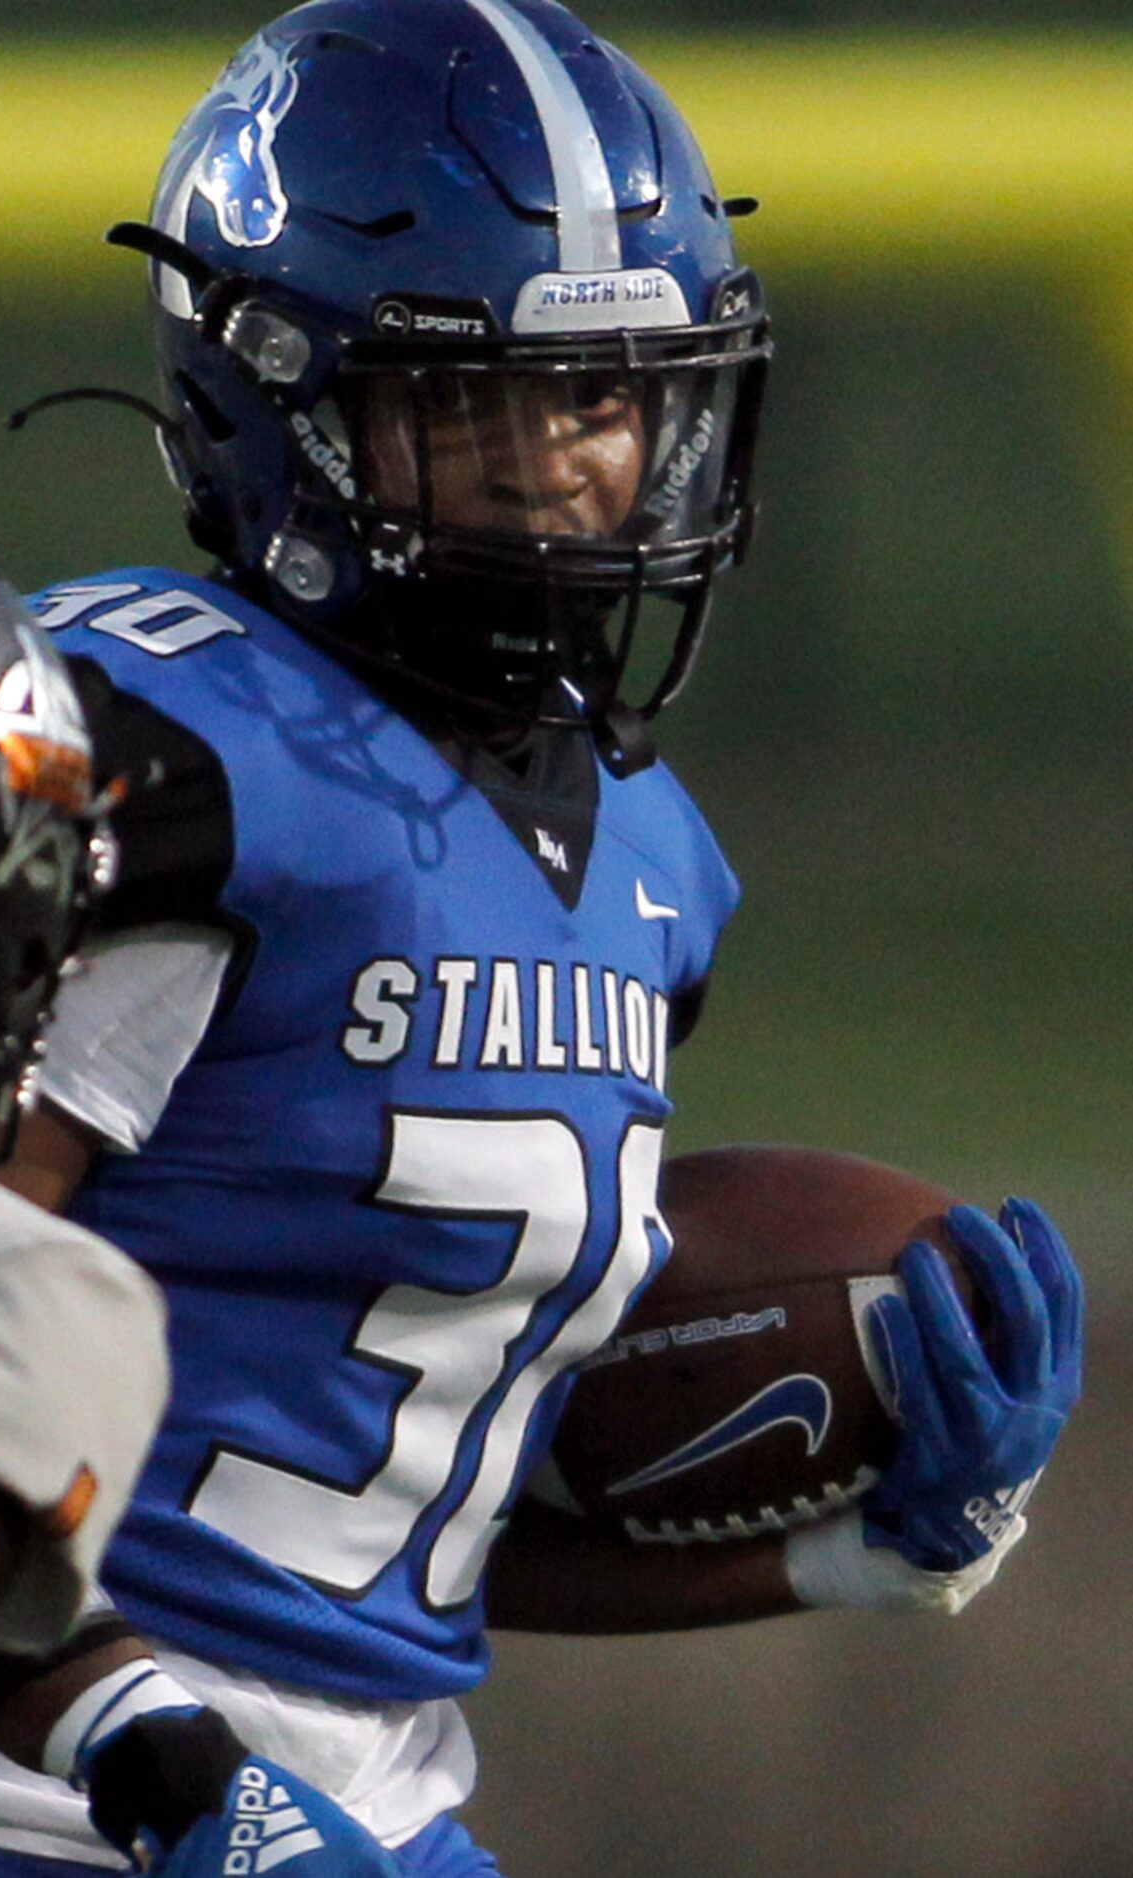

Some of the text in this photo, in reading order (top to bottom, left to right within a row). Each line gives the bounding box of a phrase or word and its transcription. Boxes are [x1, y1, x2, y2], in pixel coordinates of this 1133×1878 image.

[542, 280, 616, 305] NORTH
[413, 314, 486, 335] SPORTS
[669, 1307, 786, 1345] VAPOR
[222, 1765, 271, 1876] adida
